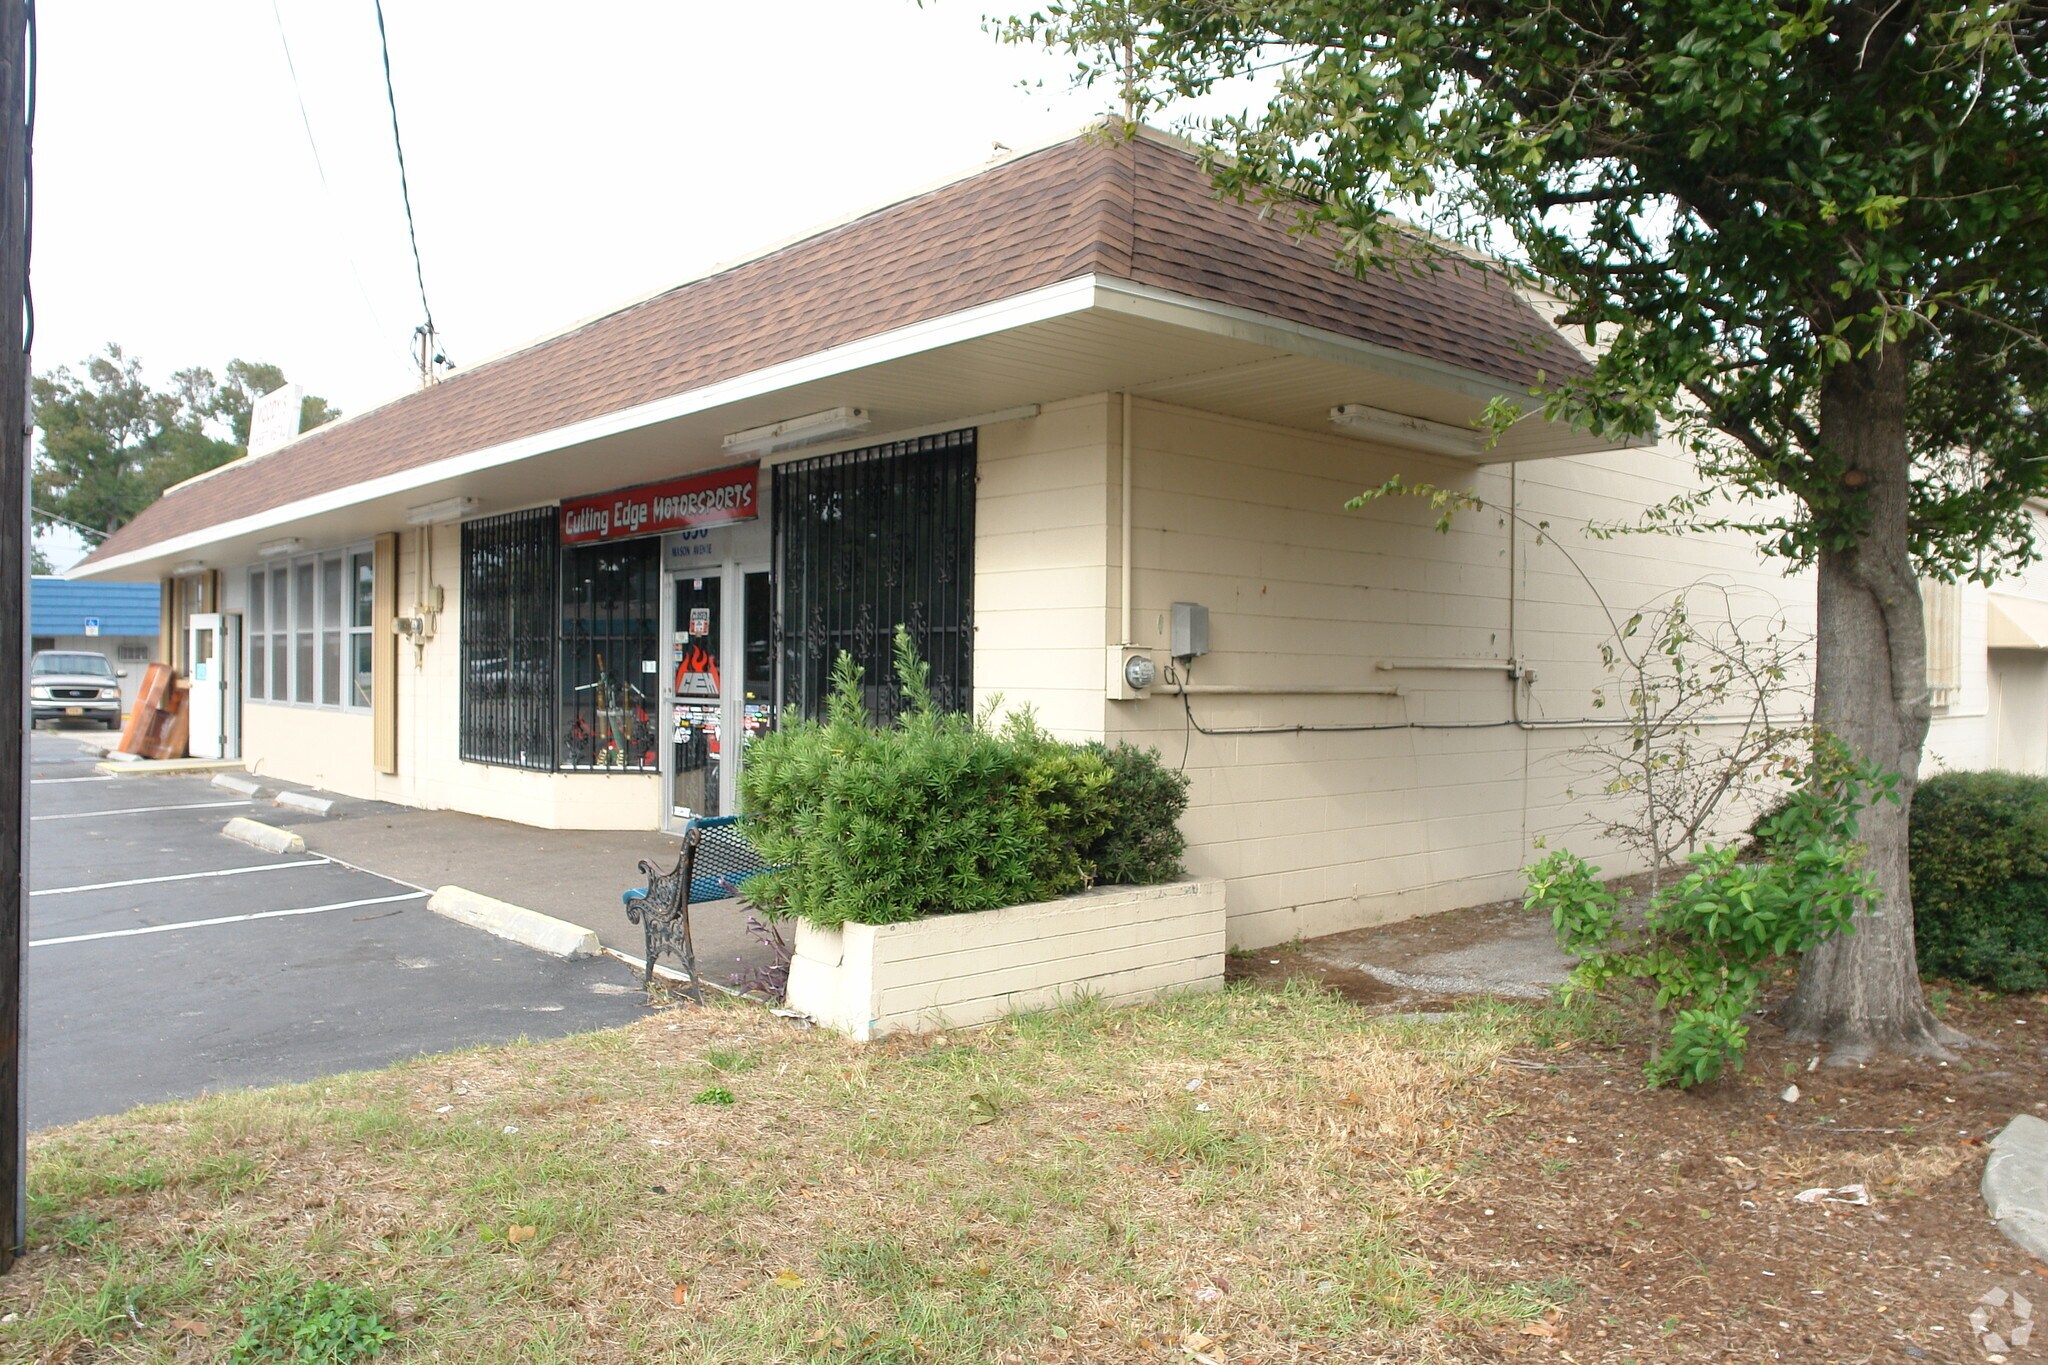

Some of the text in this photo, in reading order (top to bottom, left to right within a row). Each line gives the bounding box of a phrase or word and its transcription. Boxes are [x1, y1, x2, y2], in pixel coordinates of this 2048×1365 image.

[565, 482, 753, 535] Cutting Edge MOTORSPORTS
